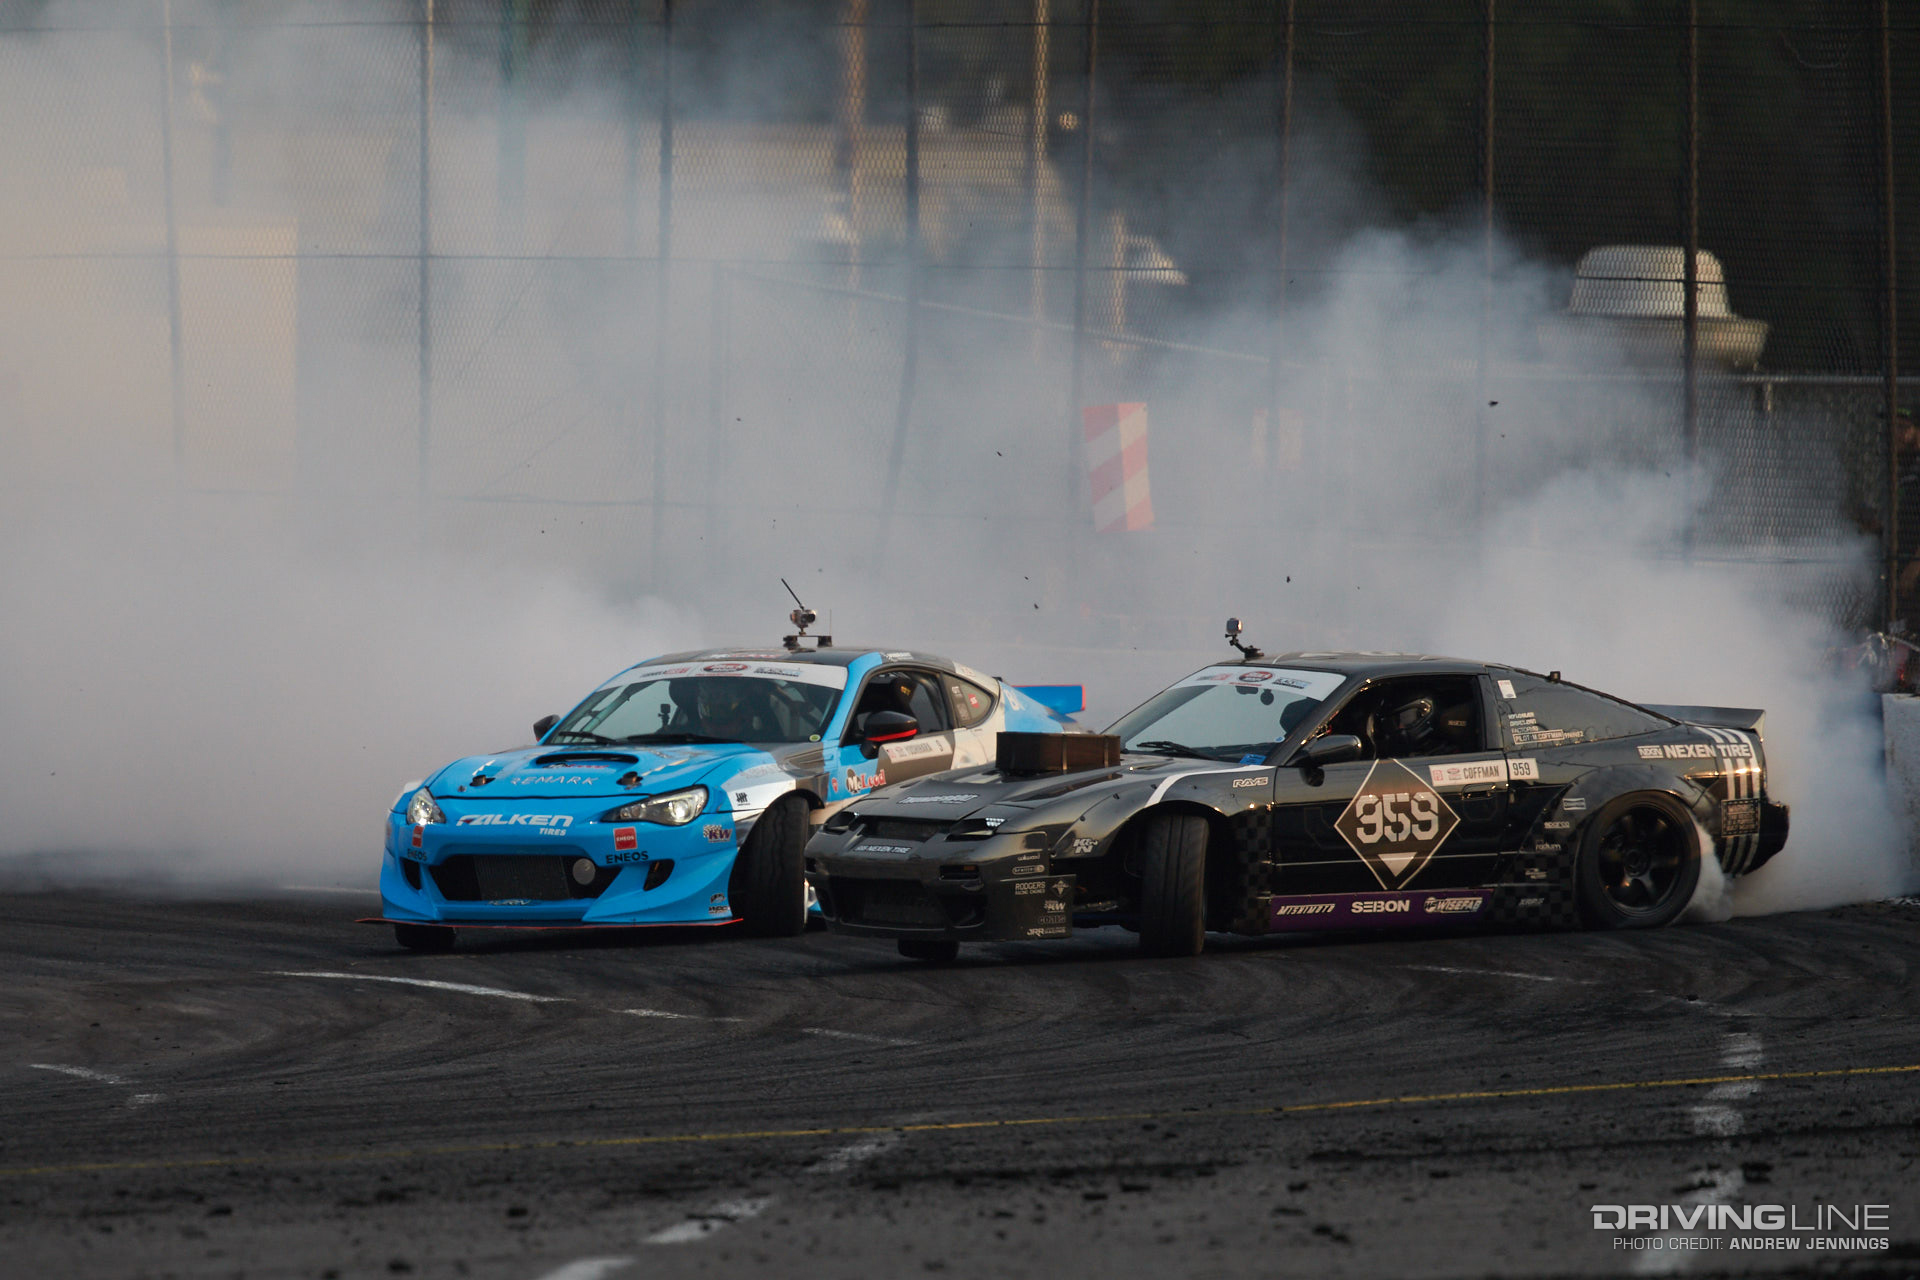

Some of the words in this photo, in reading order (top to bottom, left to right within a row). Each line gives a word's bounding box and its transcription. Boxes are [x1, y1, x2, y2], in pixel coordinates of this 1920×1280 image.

[1663, 744, 1717, 758] NEXEN
[1716, 744, 1753, 758] TIRE
[1463, 765, 1499, 779] COFFMAN
[1512, 762, 1531, 776] 959
[510, 775, 599, 785] REMARK
[1233, 777, 1269, 787] RAYS
[456, 814, 574, 827] FALKEN
[1355, 791, 1439, 844] 959
[539, 827, 566, 836] TIRES
[407, 848, 428, 862] ENEOS
[606, 851, 649, 864] ENEOS
[1015, 881, 1045, 890] RODGERS
[1351, 899, 1410, 914] SEBON
